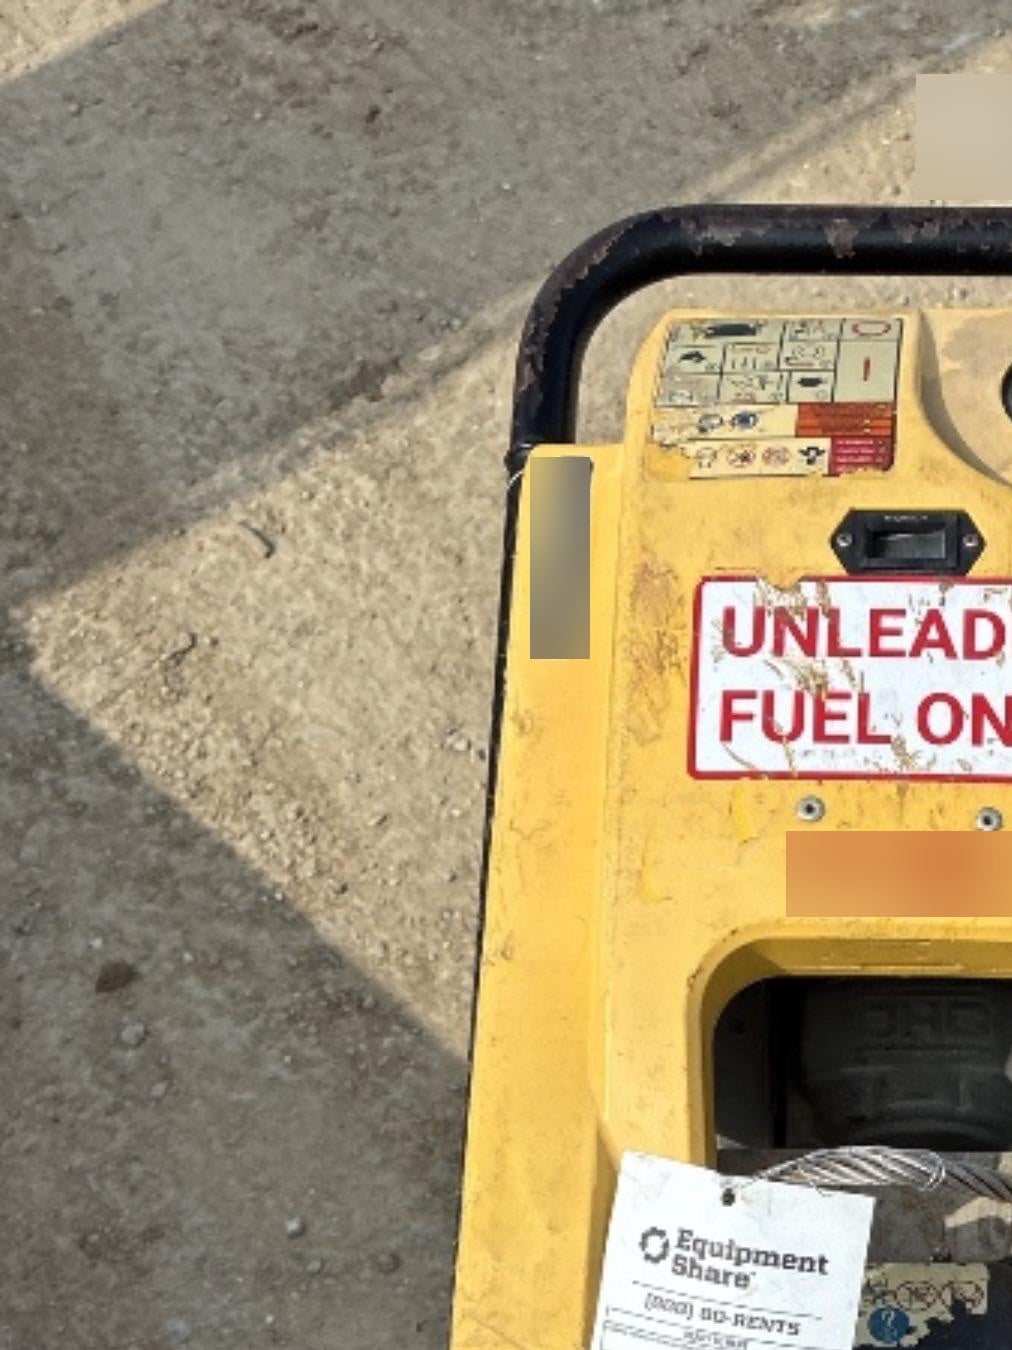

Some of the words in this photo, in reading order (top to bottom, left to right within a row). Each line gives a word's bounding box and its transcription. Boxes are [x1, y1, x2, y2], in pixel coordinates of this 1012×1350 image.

[719, 689, 892, 746] FUEL
[671, 1253, 751, 1290] Share
[675, 1227, 829, 1275] Equipment
